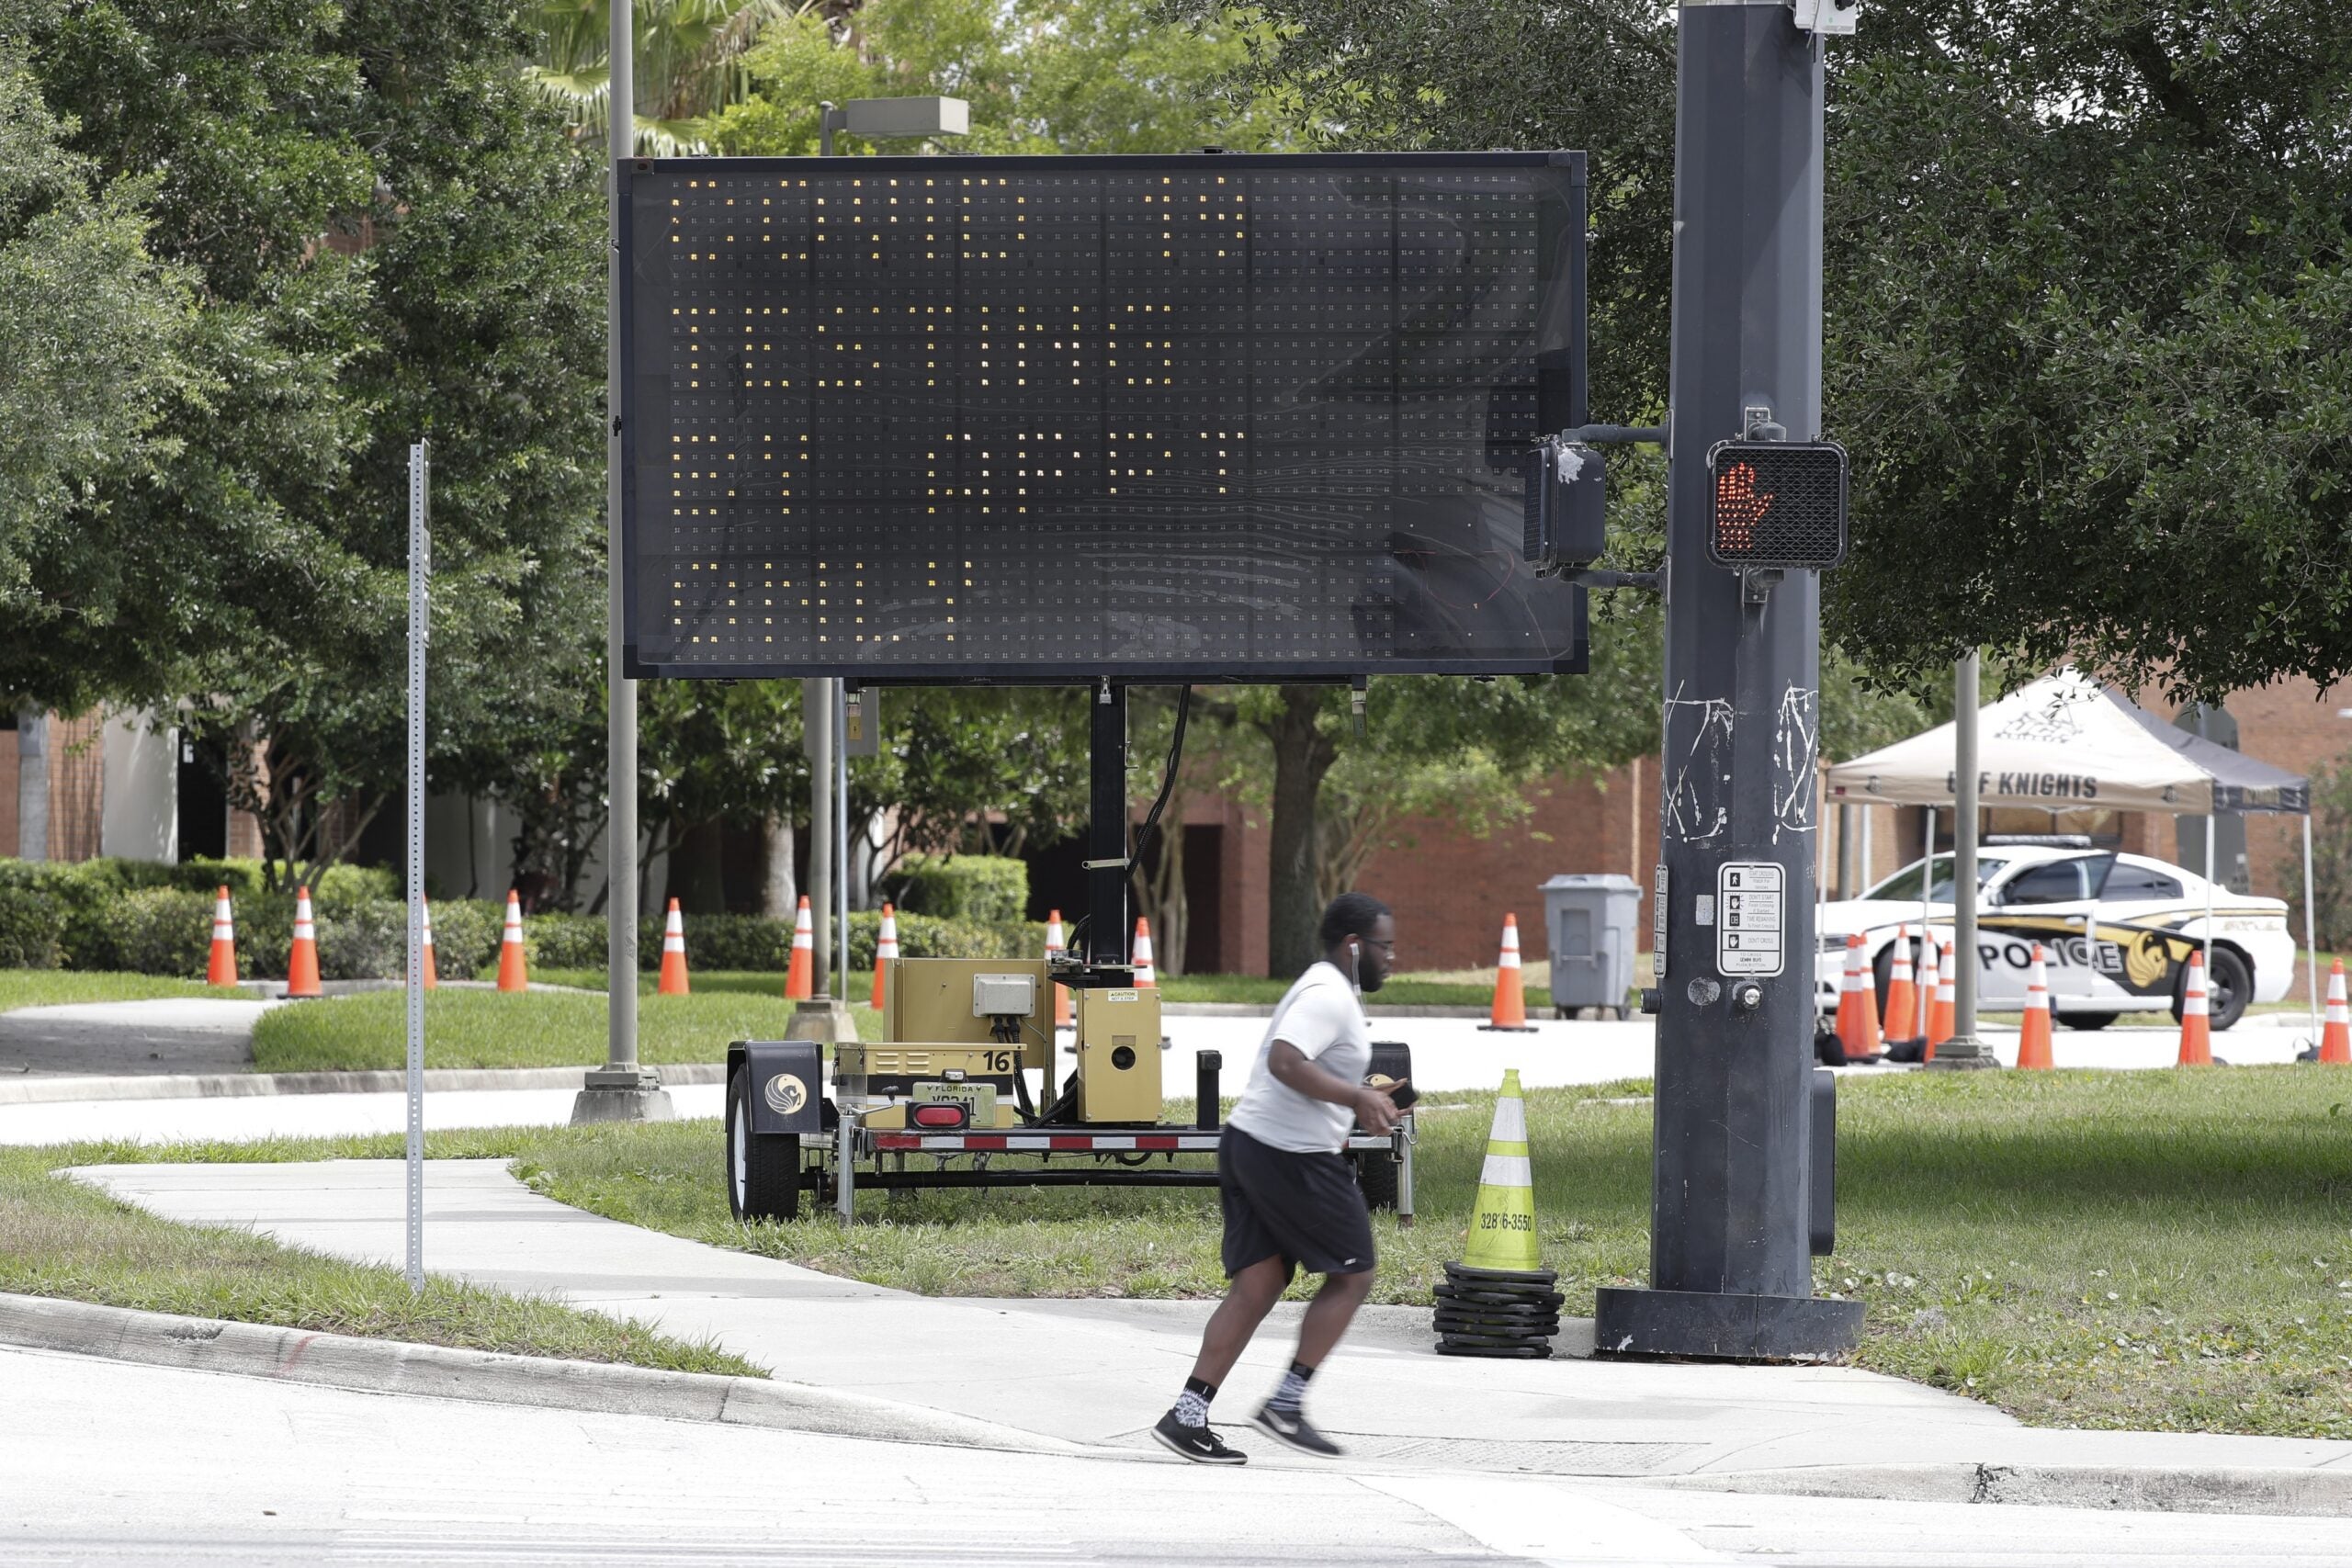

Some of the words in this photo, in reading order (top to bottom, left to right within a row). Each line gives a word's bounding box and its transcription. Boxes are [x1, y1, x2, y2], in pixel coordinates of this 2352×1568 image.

[672, 177, 1025, 261] COVID
[1144, 175, 1244, 258] 19
[672, 304, 1171, 389] TESTING
[673, 434, 808, 516] BY
[927, 431, 1245, 514] APPT
[673, 560, 973, 644] ONLY
[1947, 771, 1991, 795] UF
[1997, 773, 2098, 798] KNIGHTS
[935, 1085, 974, 1093] FLORIDA
[983, 1050, 1011, 1072] 16
